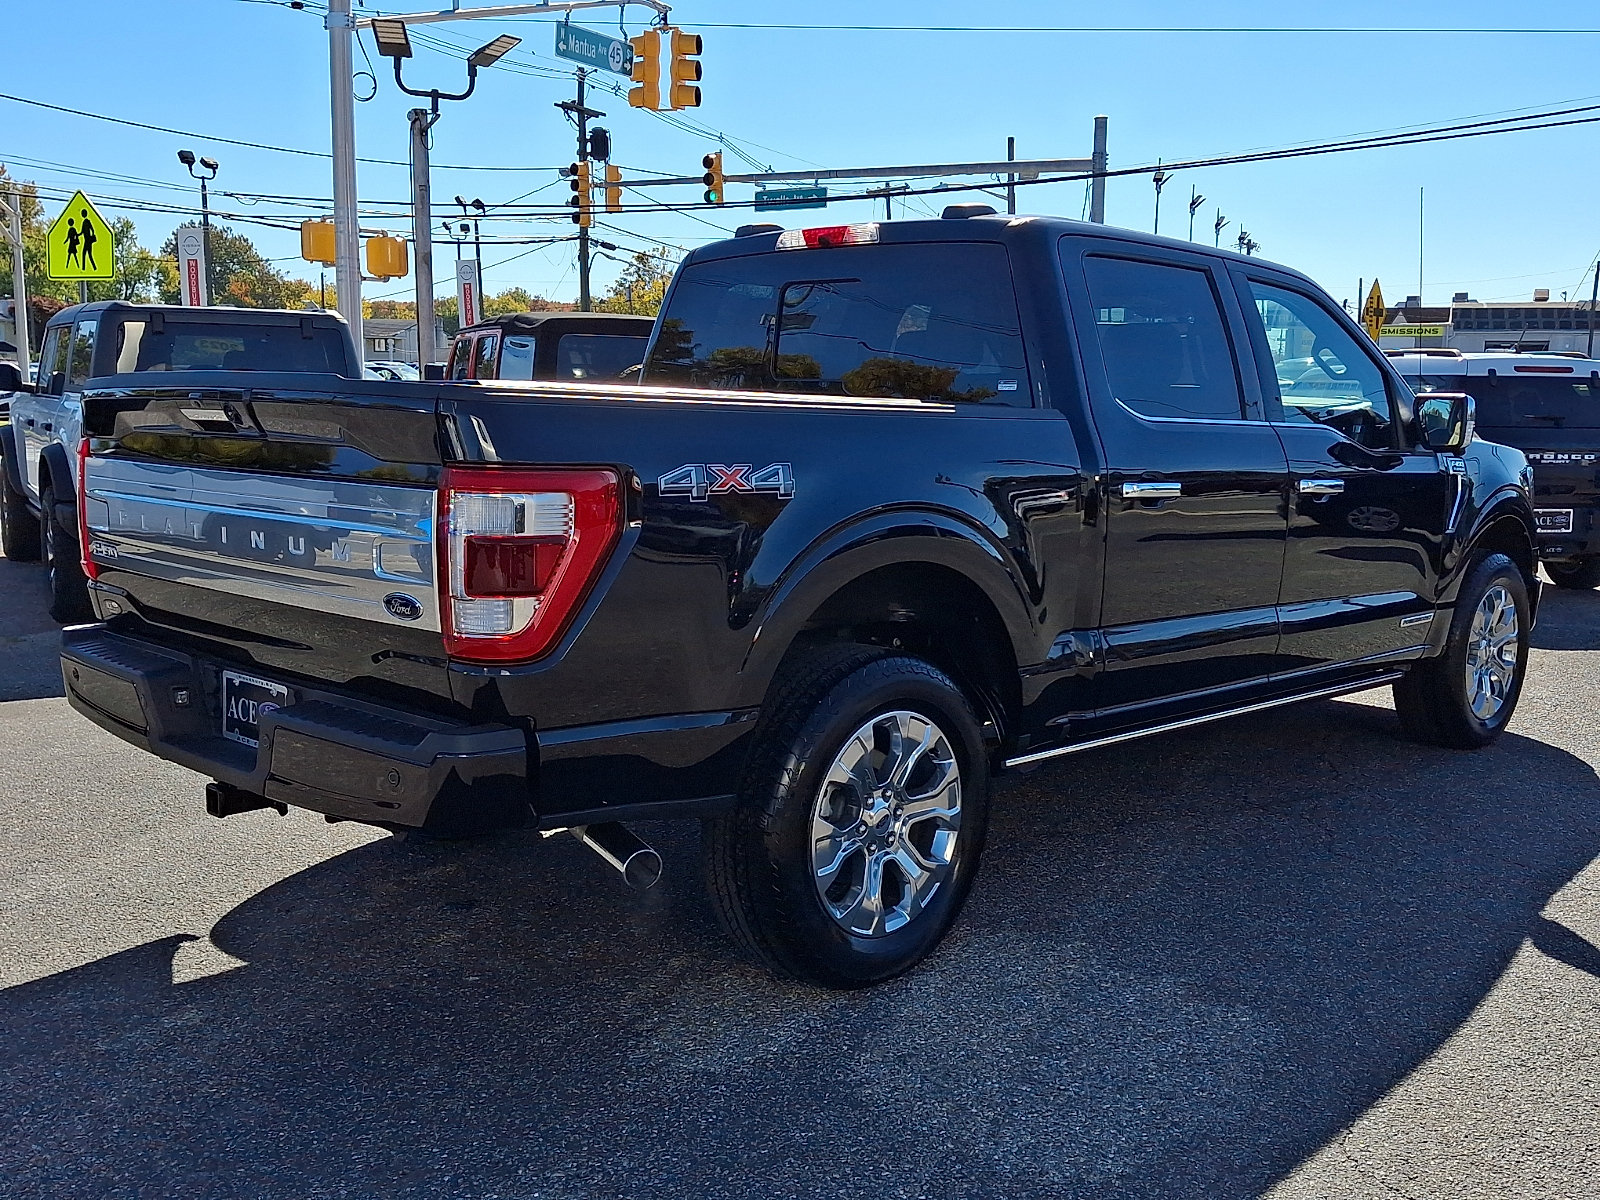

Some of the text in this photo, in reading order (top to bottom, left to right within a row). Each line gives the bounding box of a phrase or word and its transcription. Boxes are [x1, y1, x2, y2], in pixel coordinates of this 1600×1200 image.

[568, 34, 607, 58] Mantua Ave
[609, 46, 622, 64] 45
[119, 510, 350, 562] PLATINUM
[390, 598, 412, 615] Ford
[227, 695, 258, 725] ACE
